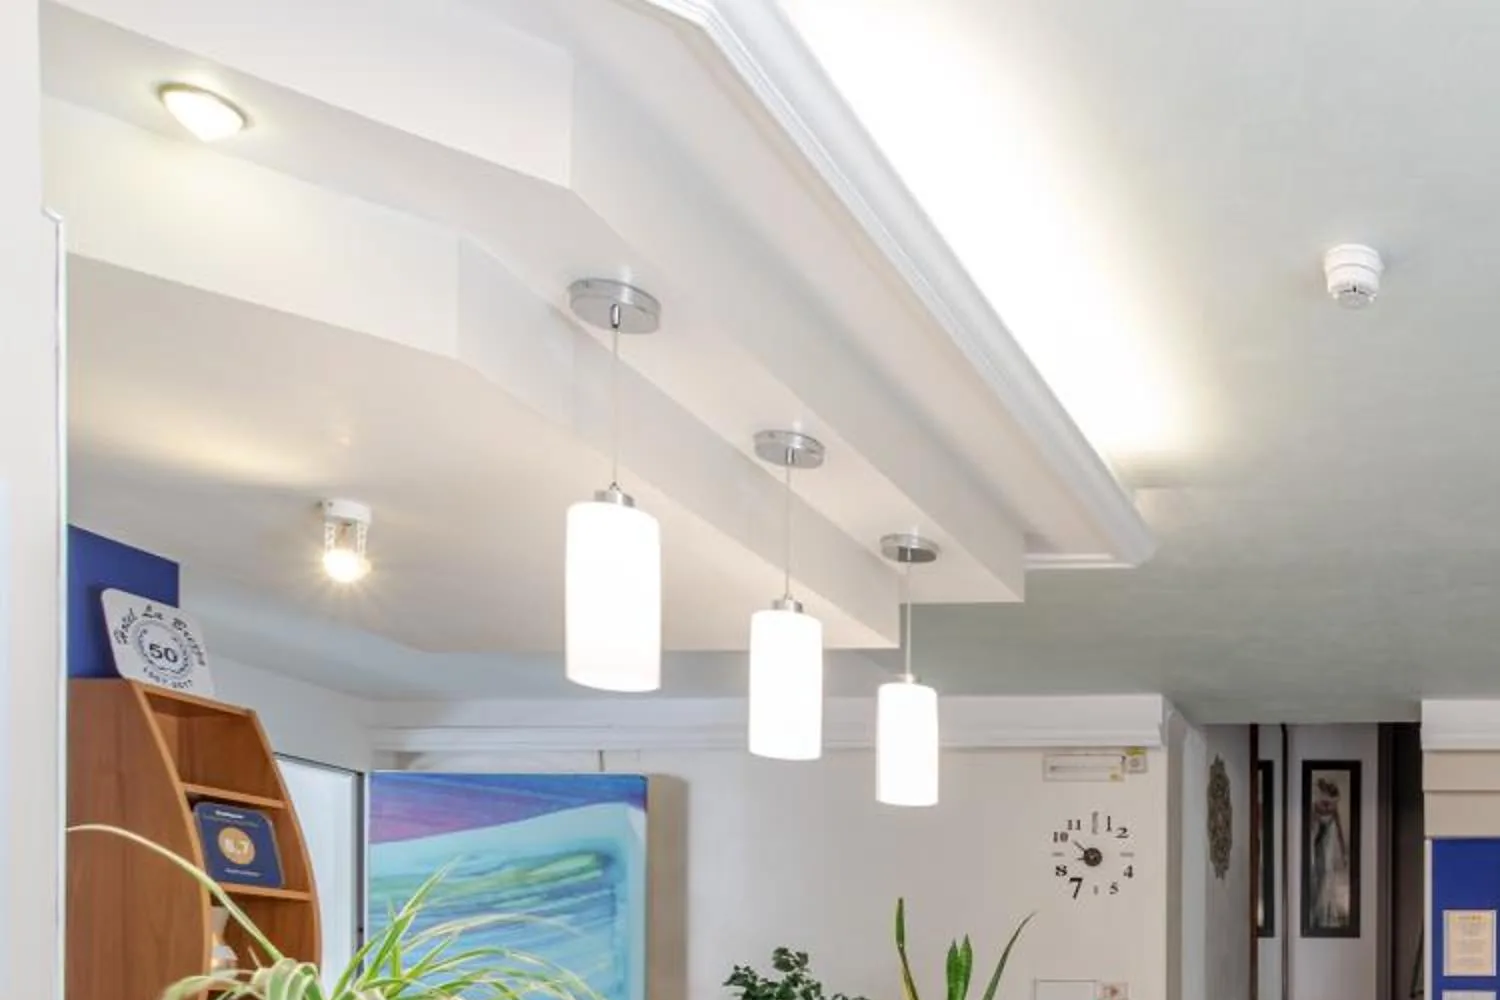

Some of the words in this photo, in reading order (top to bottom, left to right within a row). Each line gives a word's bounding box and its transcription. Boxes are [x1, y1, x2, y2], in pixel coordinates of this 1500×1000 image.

[149, 643, 178, 663] 50
[1067, 819, 1081, 830] 11
[1106, 815, 1112, 832] 1
[1053, 831, 1069, 843] 10
[1115, 827, 1129, 838] 2
[1055, 865, 1068, 877] 8
[1123, 865, 1134, 879] 4
[1069, 877, 1083, 900] 7
[1109, 882, 1119, 895] 5
